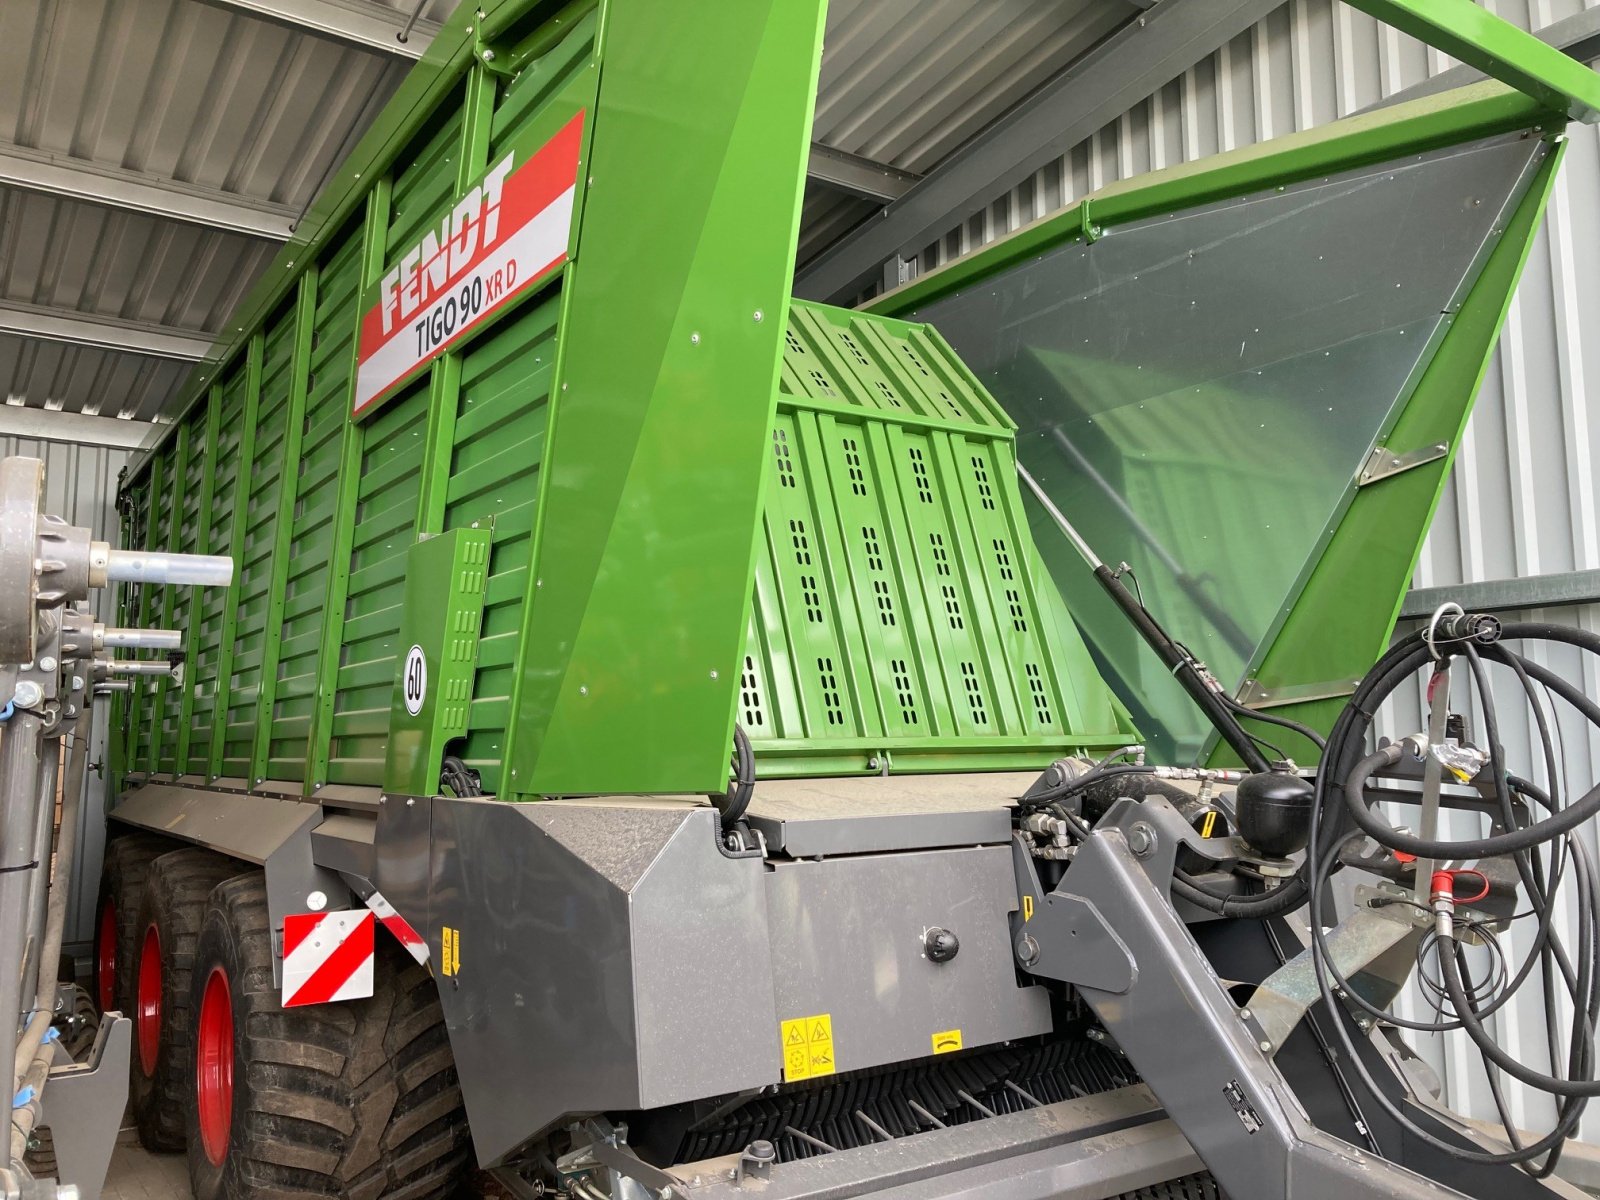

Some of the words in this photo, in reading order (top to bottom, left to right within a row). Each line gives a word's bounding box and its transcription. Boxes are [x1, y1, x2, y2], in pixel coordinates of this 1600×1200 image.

[381, 150, 515, 336] FENDT
[415, 297, 457, 357] TIGO
[460, 276, 482, 325] 90
[485, 269, 502, 306] XR
[506, 258, 517, 289] D
[408, 657, 421, 701] 60
[791, 1068, 805, 1076] STOP
